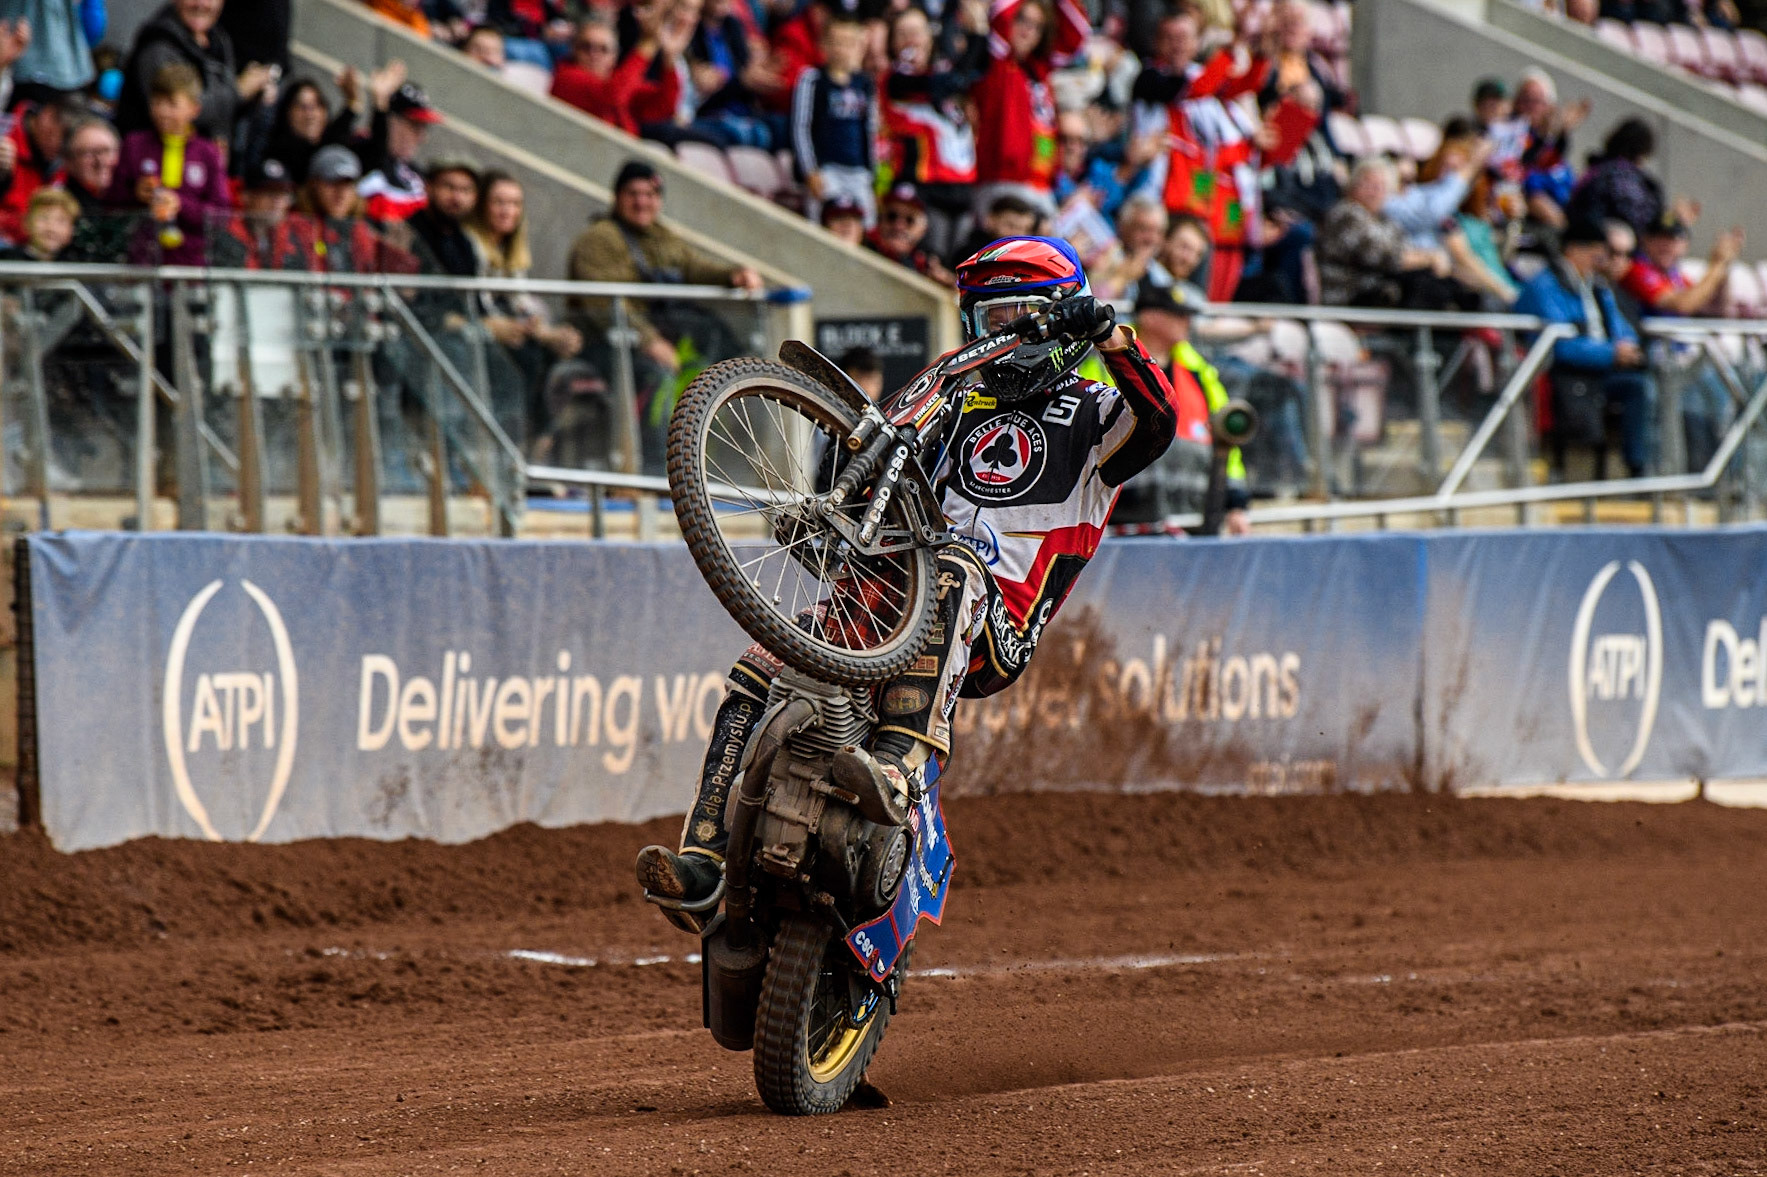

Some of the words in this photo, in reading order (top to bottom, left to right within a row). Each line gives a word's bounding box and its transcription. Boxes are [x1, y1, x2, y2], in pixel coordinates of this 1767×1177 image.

[969, 419, 1002, 443] BELLE
[1028, 428, 1043, 453] ACES
[969, 481, 1012, 494] MANCHESTER
[1588, 633, 1648, 701] ATPI
[188, 672, 275, 752] ATPI
[357, 649, 643, 775] Delivering
[1101, 633, 1300, 722] solutions
